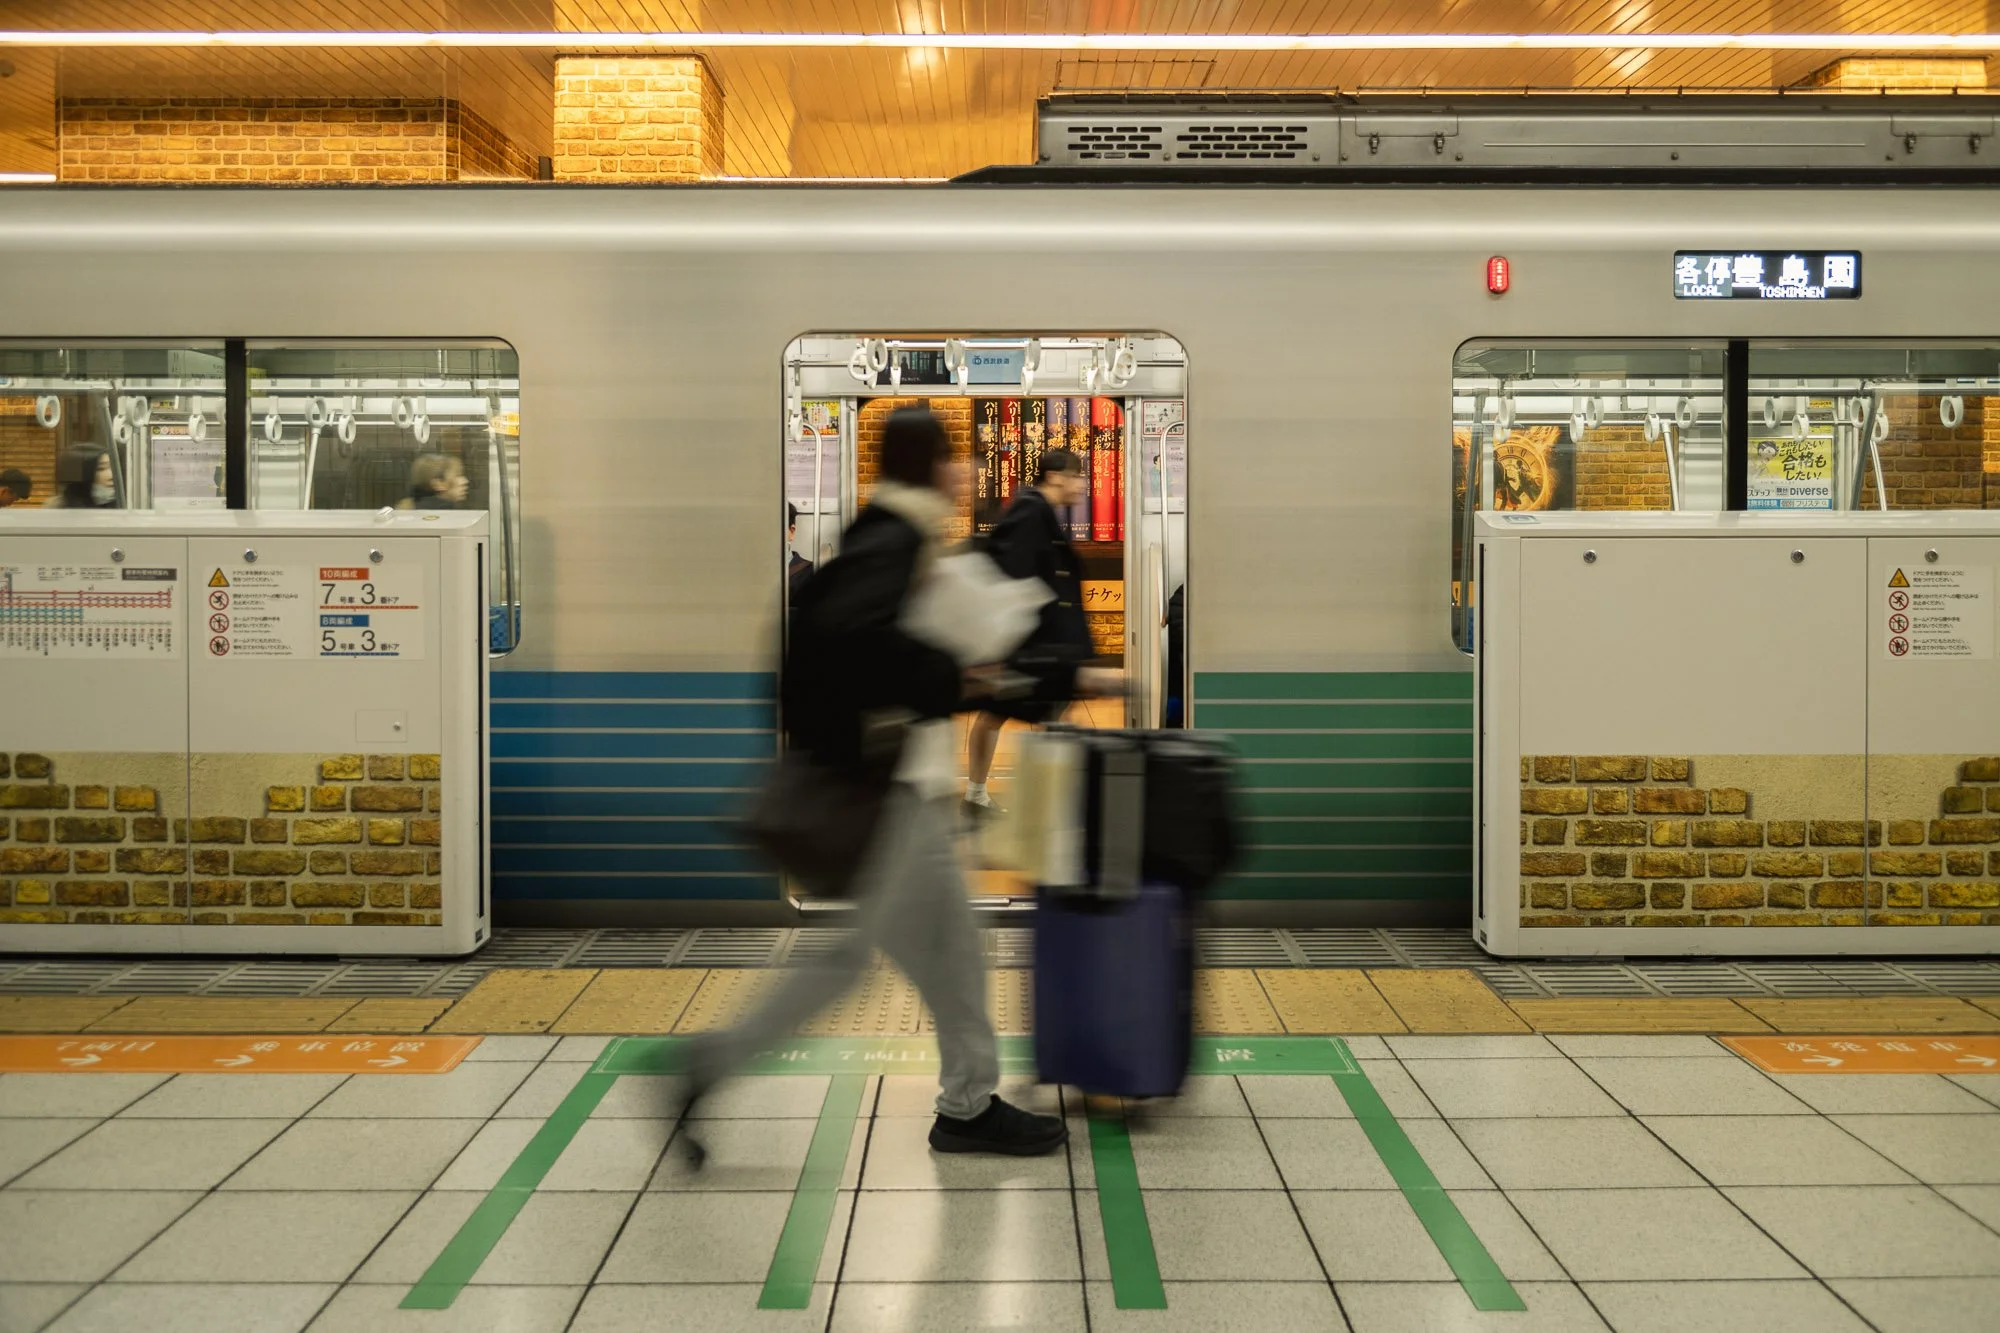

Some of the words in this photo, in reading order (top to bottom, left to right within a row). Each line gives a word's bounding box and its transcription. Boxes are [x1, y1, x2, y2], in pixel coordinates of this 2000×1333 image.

[1676, 256, 1731, 285] 各停
[1732, 254, 1854, 288] 豊島園
[1683, 284, 1722, 297] LOCAL
[1759, 286, 1825, 298] TOSHIMAEN
[984, 401, 995, 477] ハリー・ポッターと
[1782, 451, 1826, 472] 合格も
[322, 570, 358, 578] 10両編成
[1086, 588, 1122, 602] チケッ
[322, 617, 353, 626] 8両編成
